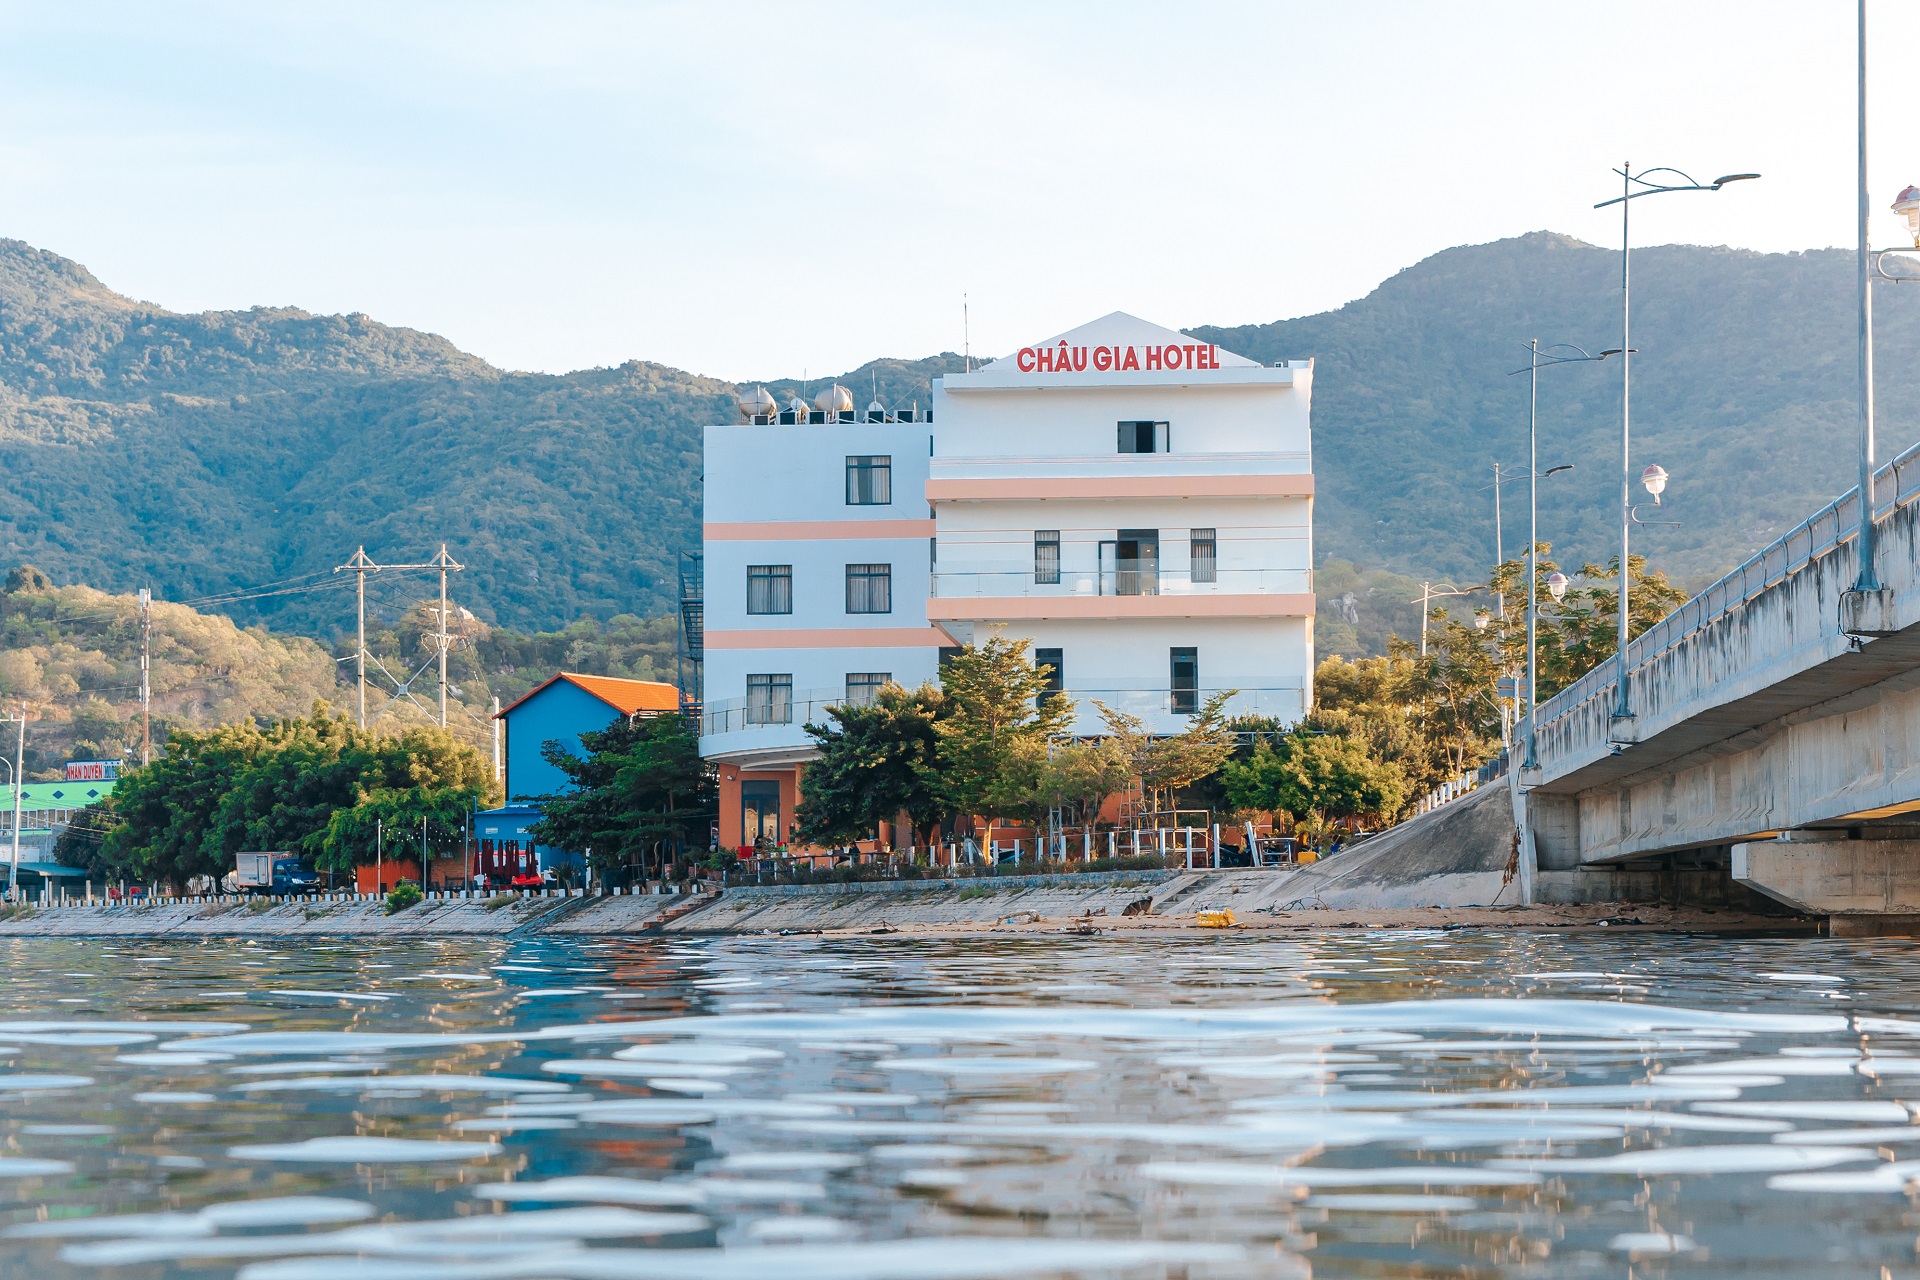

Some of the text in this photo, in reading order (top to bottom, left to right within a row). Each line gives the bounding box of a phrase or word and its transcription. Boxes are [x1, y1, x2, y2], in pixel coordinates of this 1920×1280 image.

[1017, 339, 1220, 372] CHÂU GIA HOTEL
